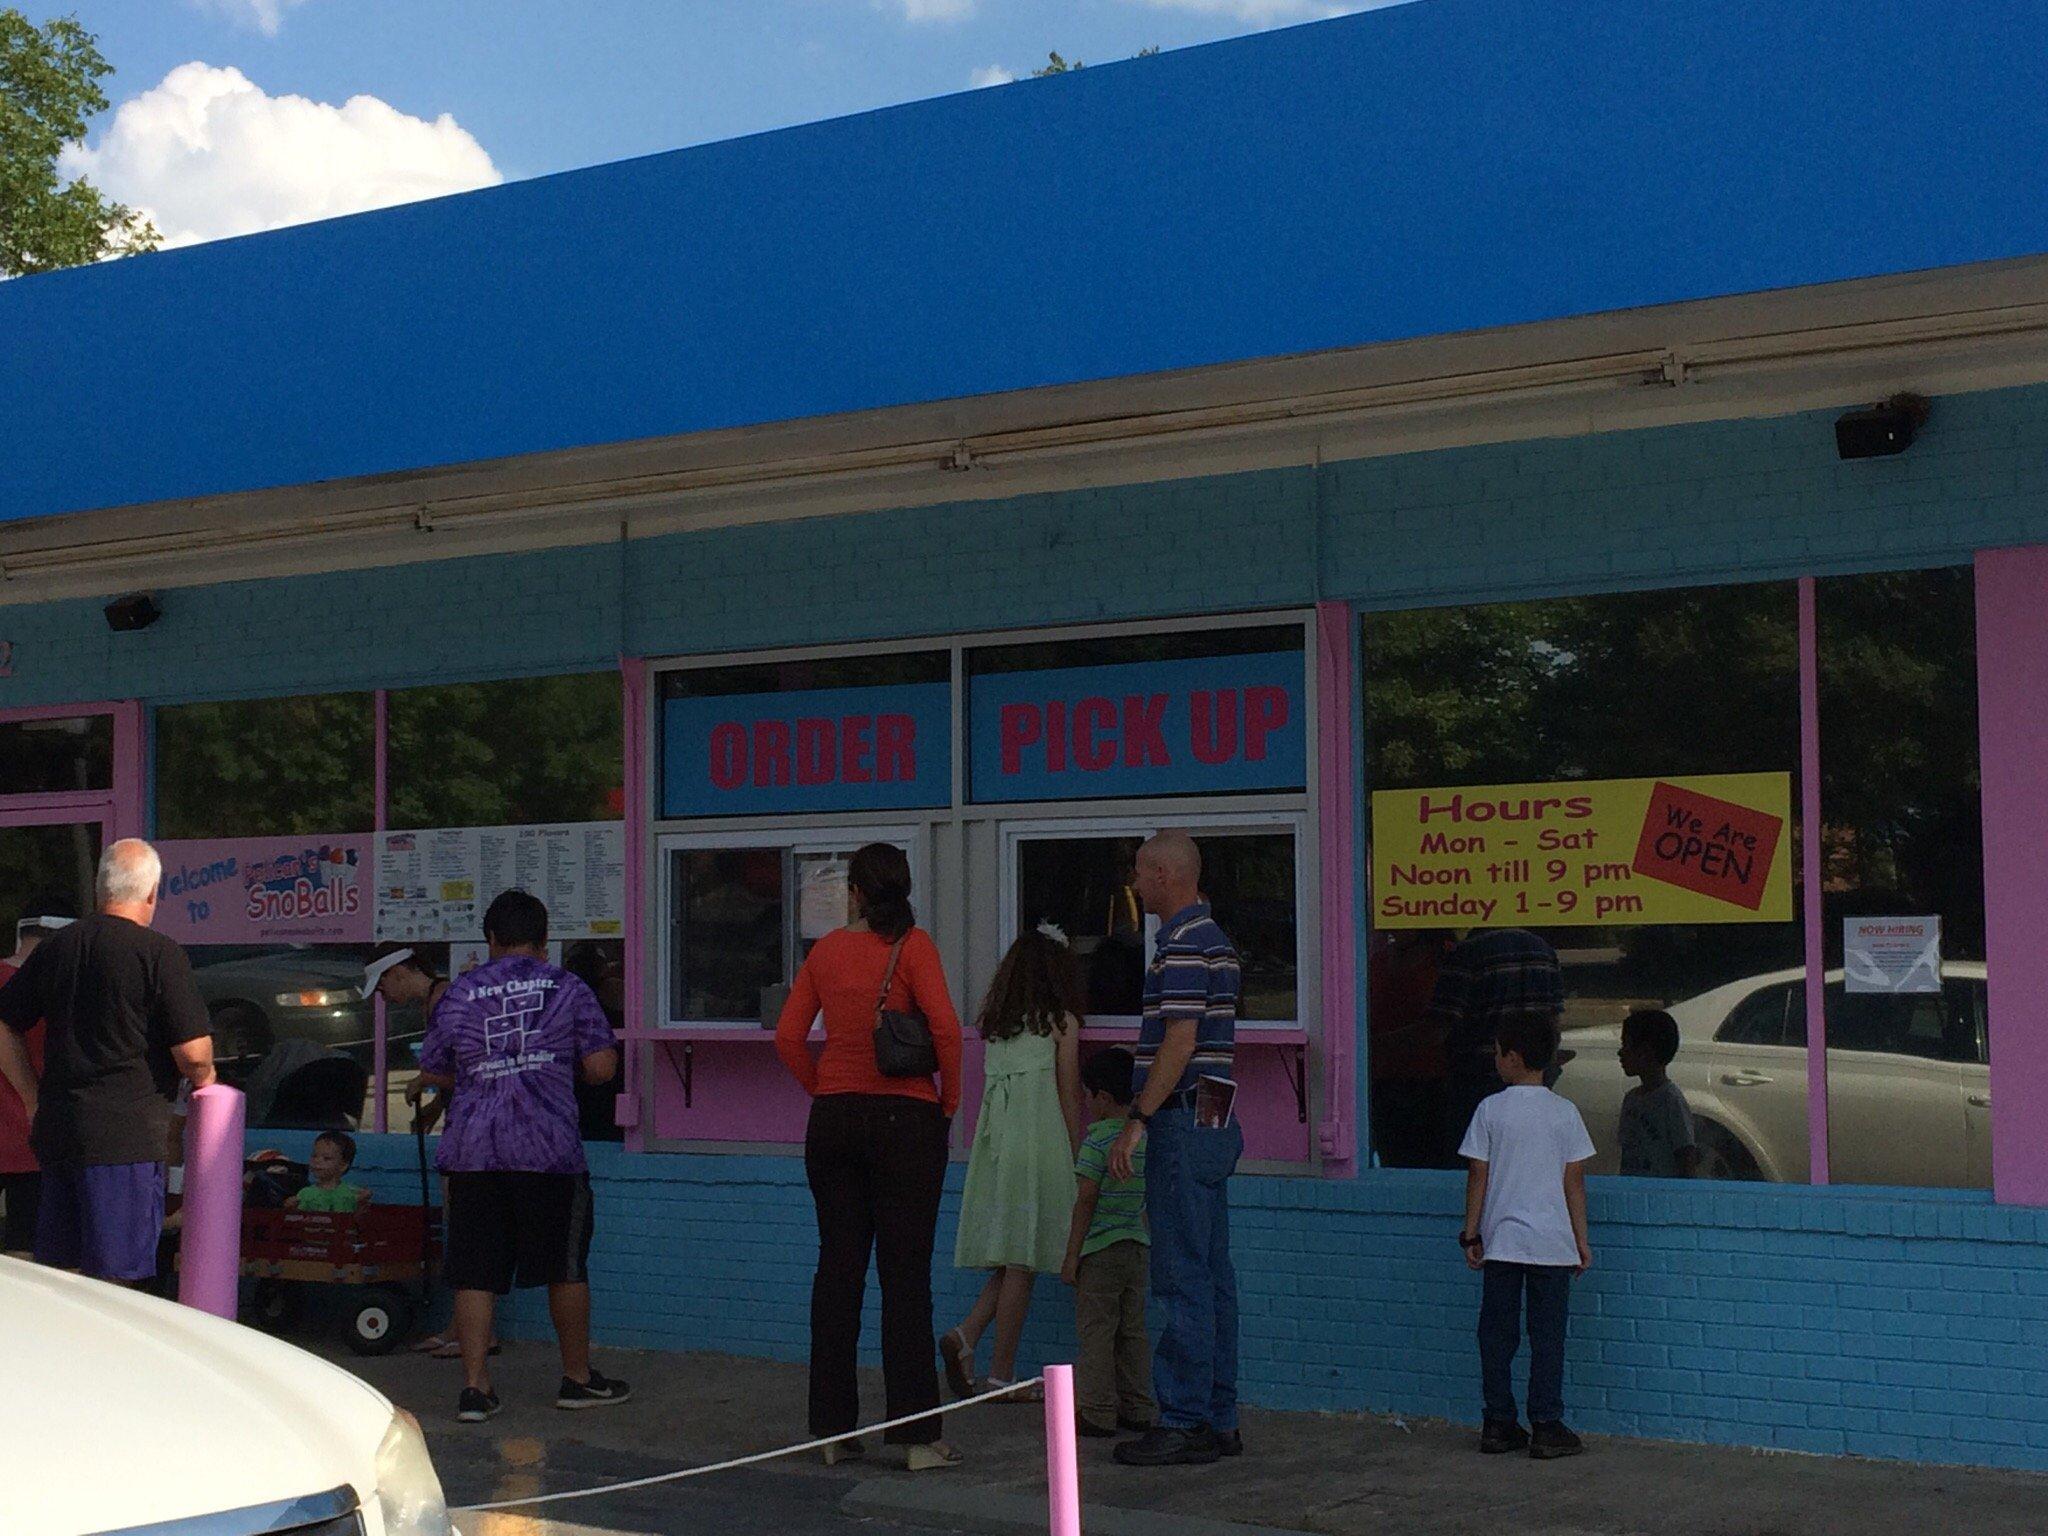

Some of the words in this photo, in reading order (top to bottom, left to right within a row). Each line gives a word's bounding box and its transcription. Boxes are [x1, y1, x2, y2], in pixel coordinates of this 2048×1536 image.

[1001, 692, 1172, 775] PICK
[1189, 684, 1290, 765] UP
[708, 713, 917, 791] ORDER
[1418, 794, 1594, 824] Hours
[1419, 831, 1486, 855] Mon
[1537, 827, 1599, 851] Sat
[1665, 803, 1704, 833] We
[1713, 822, 1758, 851] Are
[1654, 830, 1754, 885] OPEN
[1390, 862, 1472, 886] Noon
[1486, 860, 1530, 884] till
[1546, 859, 1567, 883] 9
[1584, 861, 1633, 887] pm
[187, 899, 211, 924] to
[249, 876, 360, 921] SnoBalls
[1381, 892, 1498, 921] Sunday
[1515, 890, 1578, 914] 1-9
[1595, 891, 1644, 918] pm
[1858, 924, 1886, 936] NOW
[1888, 924, 1924, 936] HIRING
[466, 989, 477, 1001] A
[478, 985, 504, 998] New
